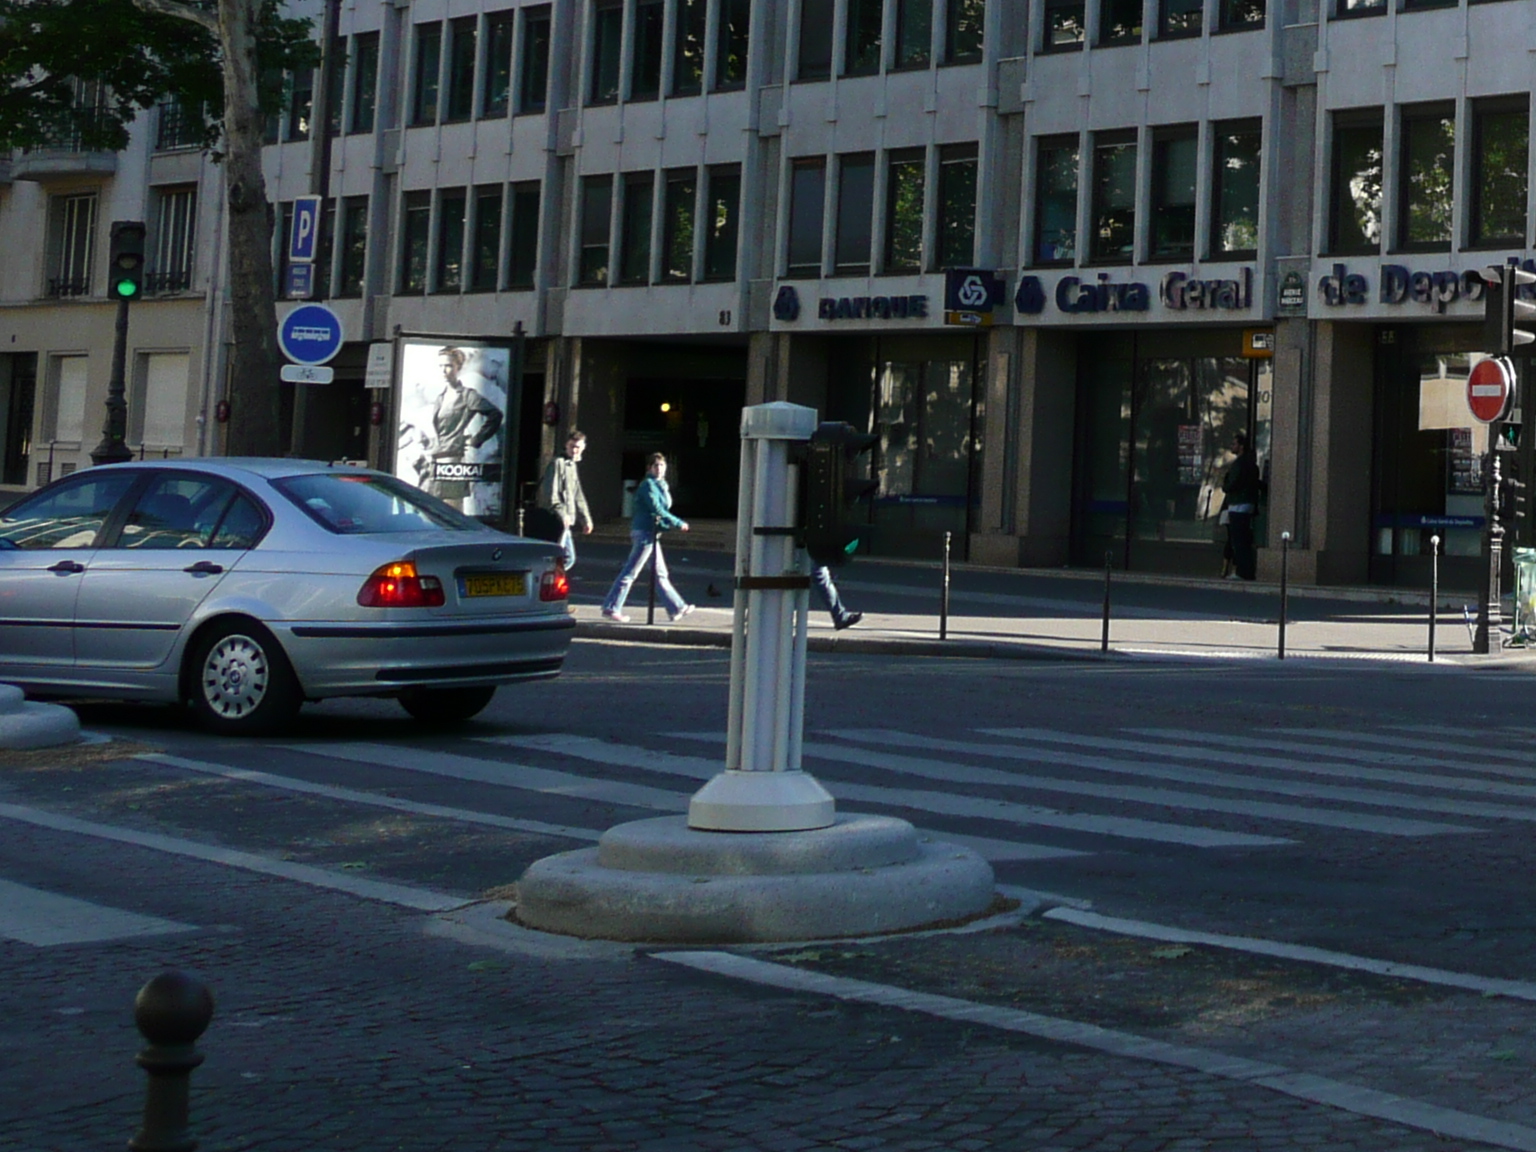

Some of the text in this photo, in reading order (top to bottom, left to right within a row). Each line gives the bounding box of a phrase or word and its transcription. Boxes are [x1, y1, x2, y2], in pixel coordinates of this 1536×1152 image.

[297, 210, 311, 249] P
[818, 295, 928, 320] BANQUE
[1056, 273, 1148, 313] Caixa
[1160, 267, 1253, 311] Geral
[1318, 263, 1367, 306] de
